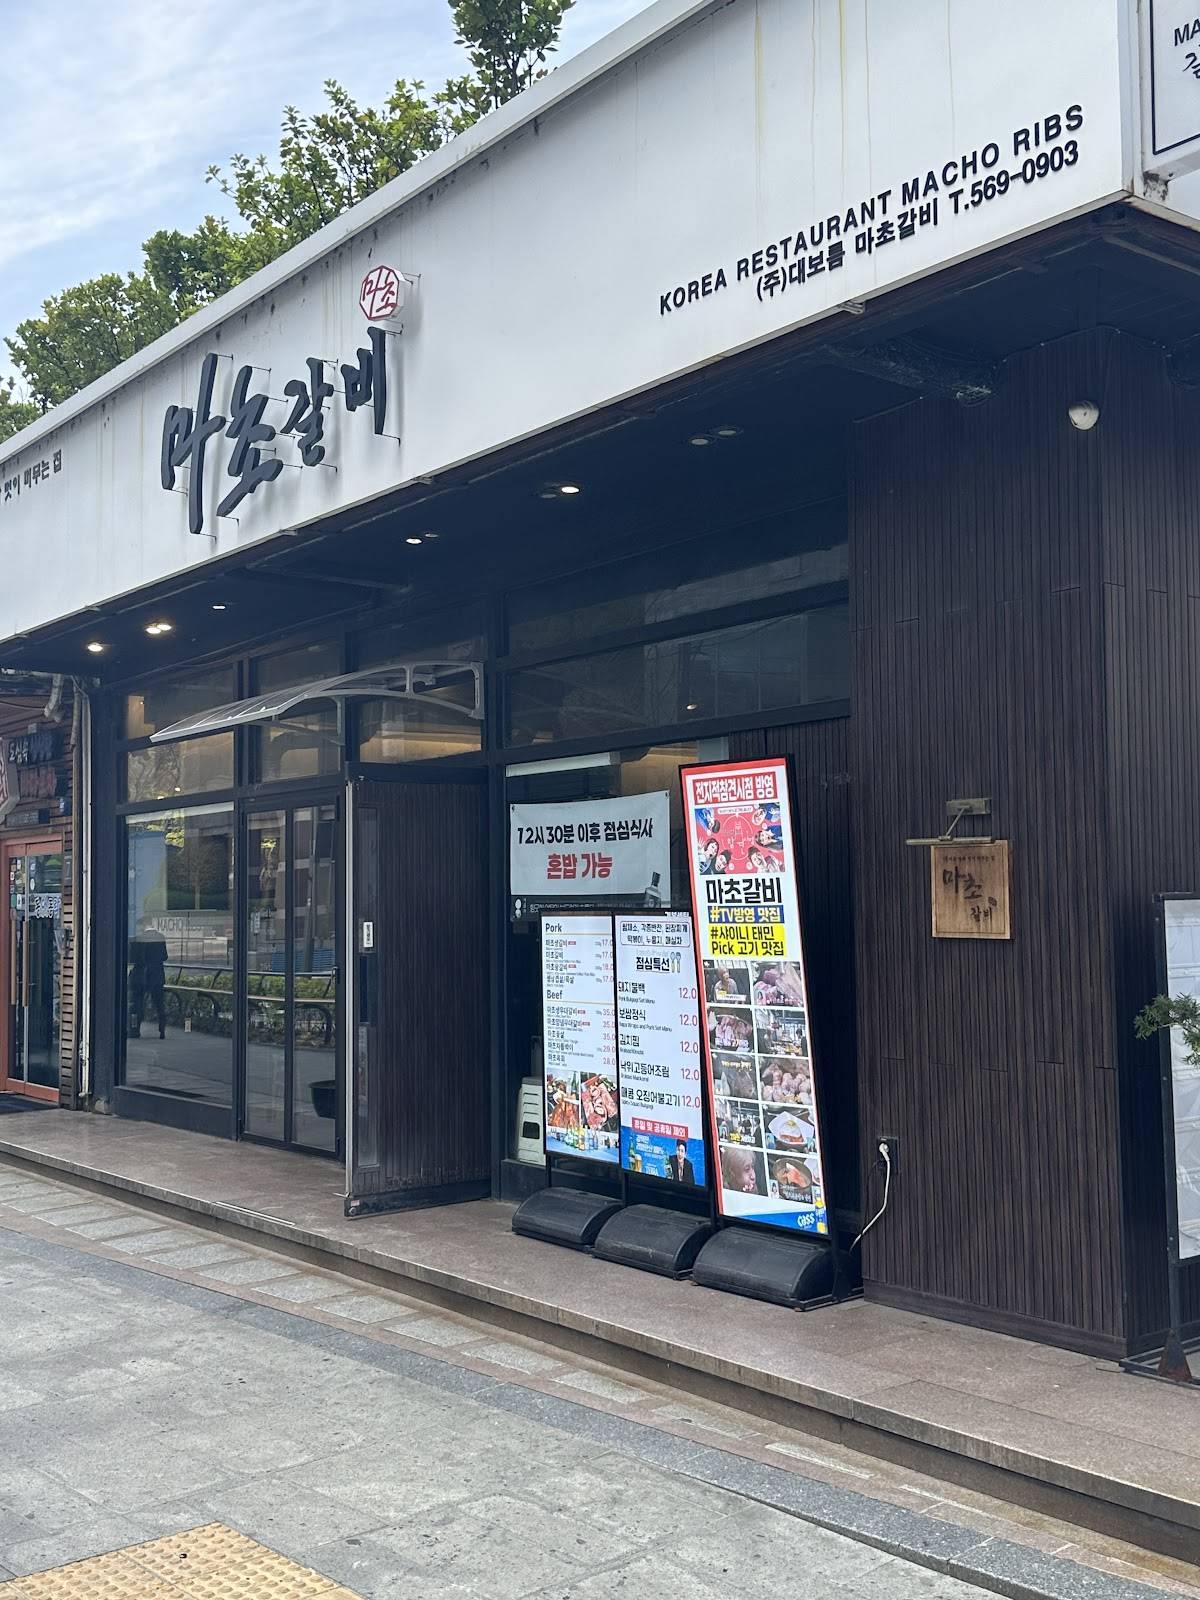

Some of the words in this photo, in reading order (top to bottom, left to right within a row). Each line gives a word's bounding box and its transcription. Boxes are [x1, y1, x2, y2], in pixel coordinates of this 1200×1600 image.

[660, 268, 727, 316] KOREA
[737, 190, 891, 281] RESTAURANT
[902, 143, 999, 206] MACHO
[1013, 104, 1083, 156] RIBS
[756, 240, 846, 301] (주)대보름
[855, 197, 938, 254] 마초갈비
[949, 140, 1079, 214] T.569-0903
[161, 326, 388, 535] 마초갈비
[53, 449, 62, 474] 집
[695, 777, 754, 803] 전지적참견시점
[755, 774, 775, 799] 방영
[578, 822, 601, 843] 이후
[603, 817, 653, 842] 점심식사
[547, 853, 578, 880] 혼밥
[581, 852, 613, 879] 가능
[705, 877, 783, 904] 마초갈비
[710, 905, 756, 923] #TV방영
[757, 906, 781, 923] 맛집
[545, 923, 562, 932] Pork
[752, 925, 775, 941] 태민
[711, 940, 735, 955] Pick
[737, 941, 759, 956] 고기
[761, 941, 785, 956] 맛집
[636, 956, 670, 972] 점심특선
[547, 989, 563, 1000] Beef
[678, 987, 697, 1000] 12.0
[619, 1007, 646, 1021] 보쌈정식
[679, 1014, 698, 1027] 12.0
[619, 1034, 640, 1047] 김치찜
[680, 1041, 699, 1054] 12.0
[681, 1067, 700, 1081] 12.0
[636, 1089, 681, 1107] 오징어불고기
[682, 1095, 701, 1109] 12.0
